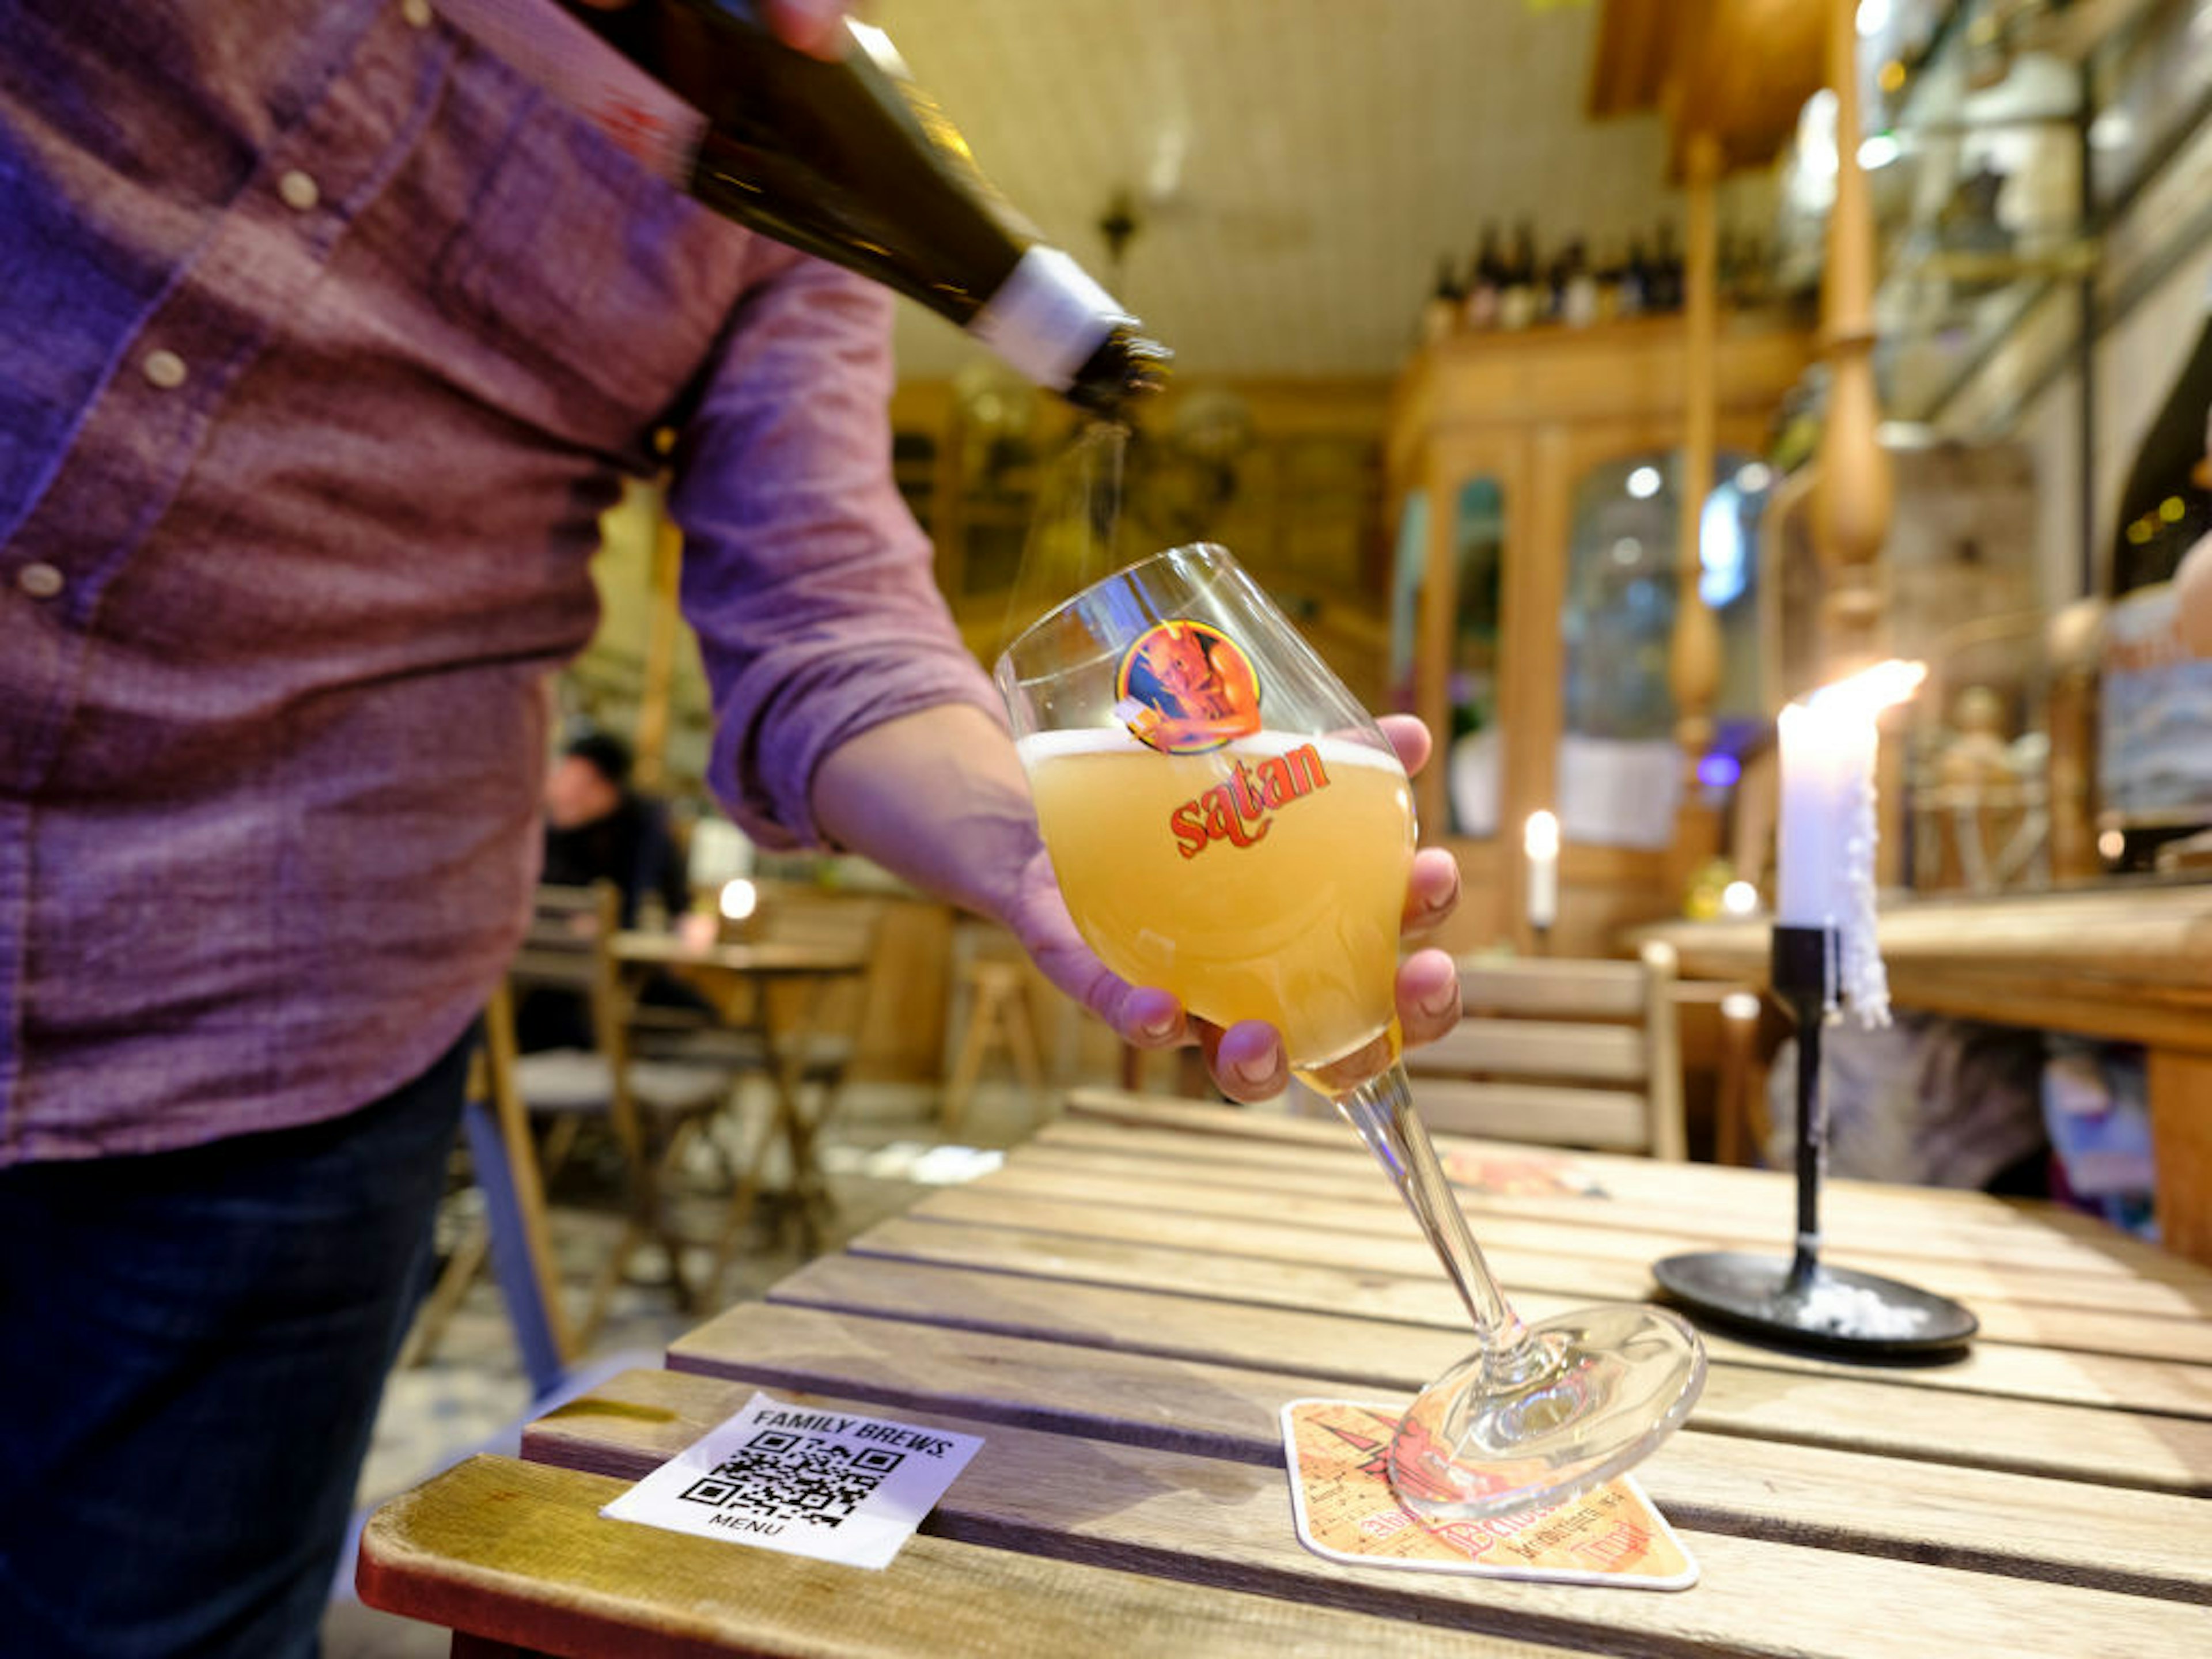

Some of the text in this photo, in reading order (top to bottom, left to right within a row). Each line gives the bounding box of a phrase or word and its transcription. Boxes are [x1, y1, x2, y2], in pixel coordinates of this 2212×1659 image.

[1170, 743, 1330, 859] satan
[753, 1410, 954, 1459] FAMILY BREWS
[709, 1513, 785, 1536] MENU
